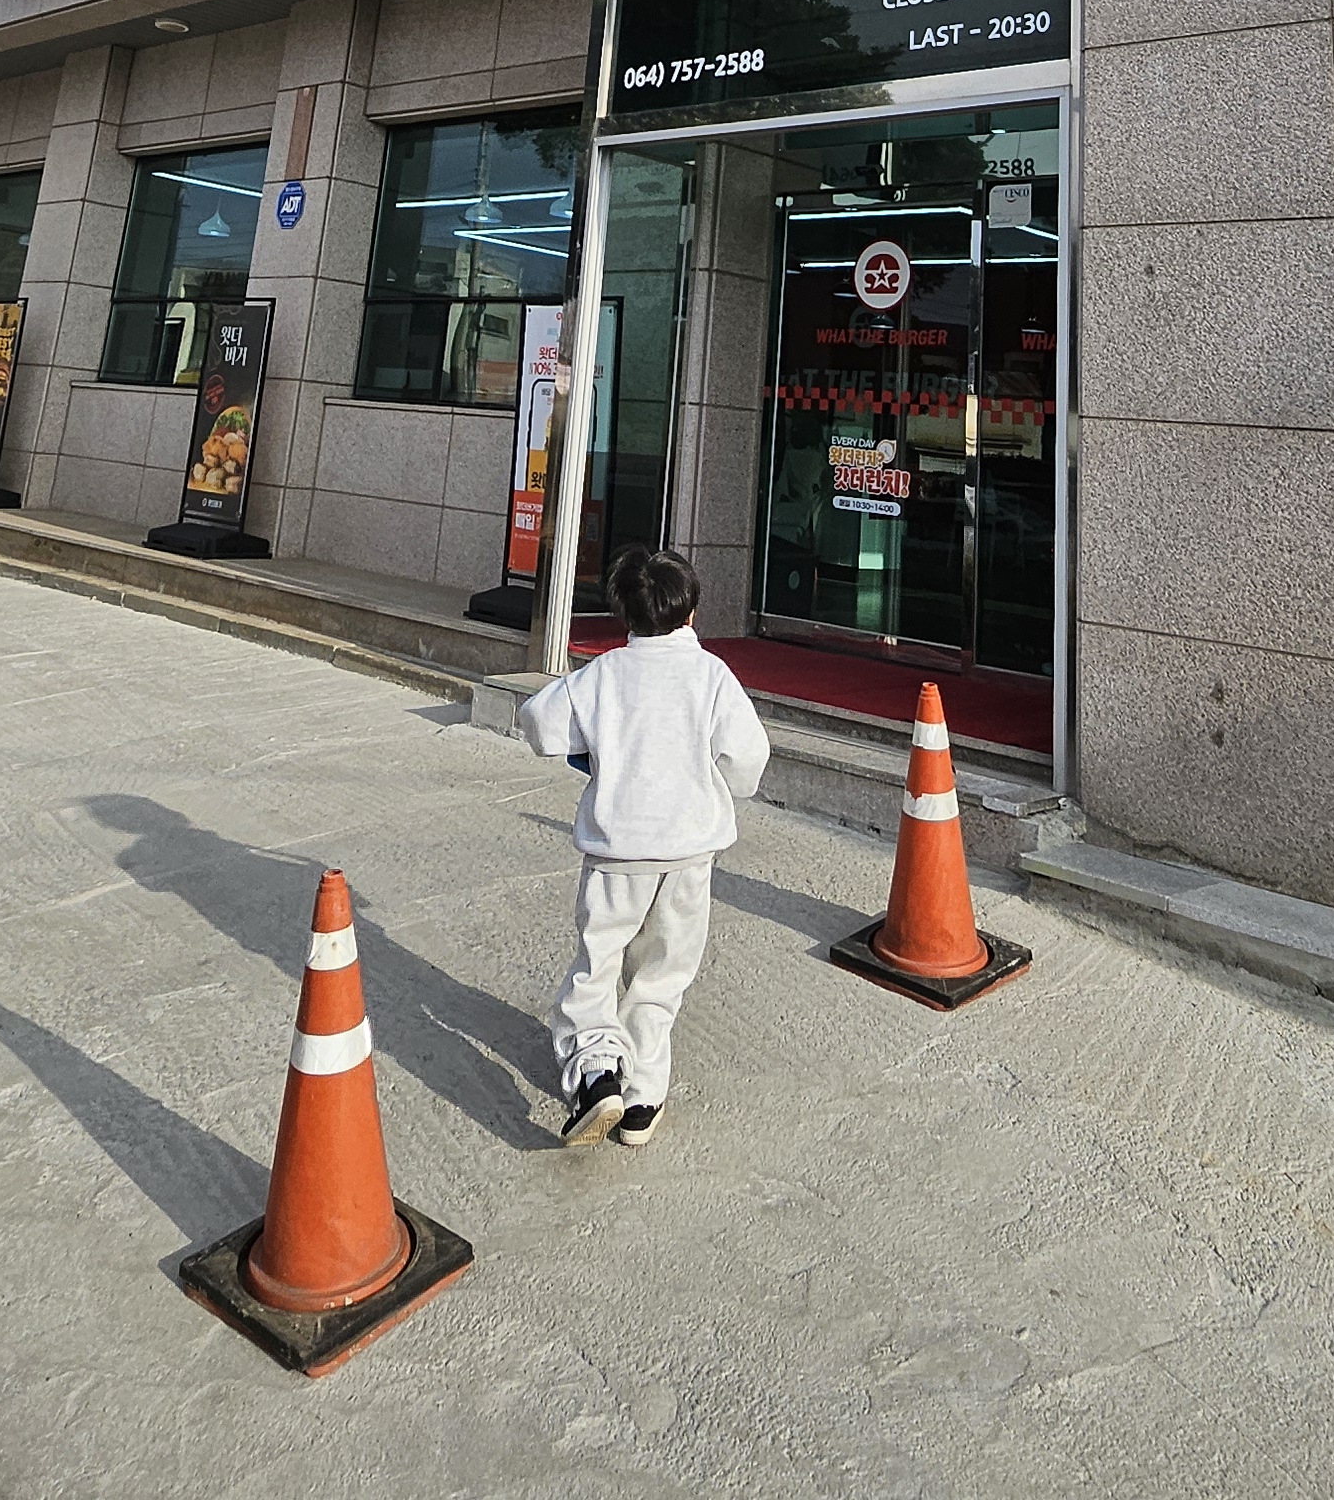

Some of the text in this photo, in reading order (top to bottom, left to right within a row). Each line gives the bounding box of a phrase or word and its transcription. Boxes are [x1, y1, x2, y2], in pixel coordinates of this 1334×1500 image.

[908, 23, 964, 51] LAST
[988, 11, 1051, 40] 20:30
[623, 48, 765, 90] 064) 757-2588
[279, 195, 303, 214] ADT
[816, 328, 949, 347] WHAT THE BURGER
[1021, 333, 1057, 351] WHA
[539, 346, 557, 360] 왓더
[831, 435, 876, 449] EVERY DAY
[829, 445, 886, 468] 왓더런치?
[834, 465, 911, 498] 갓더런치!
